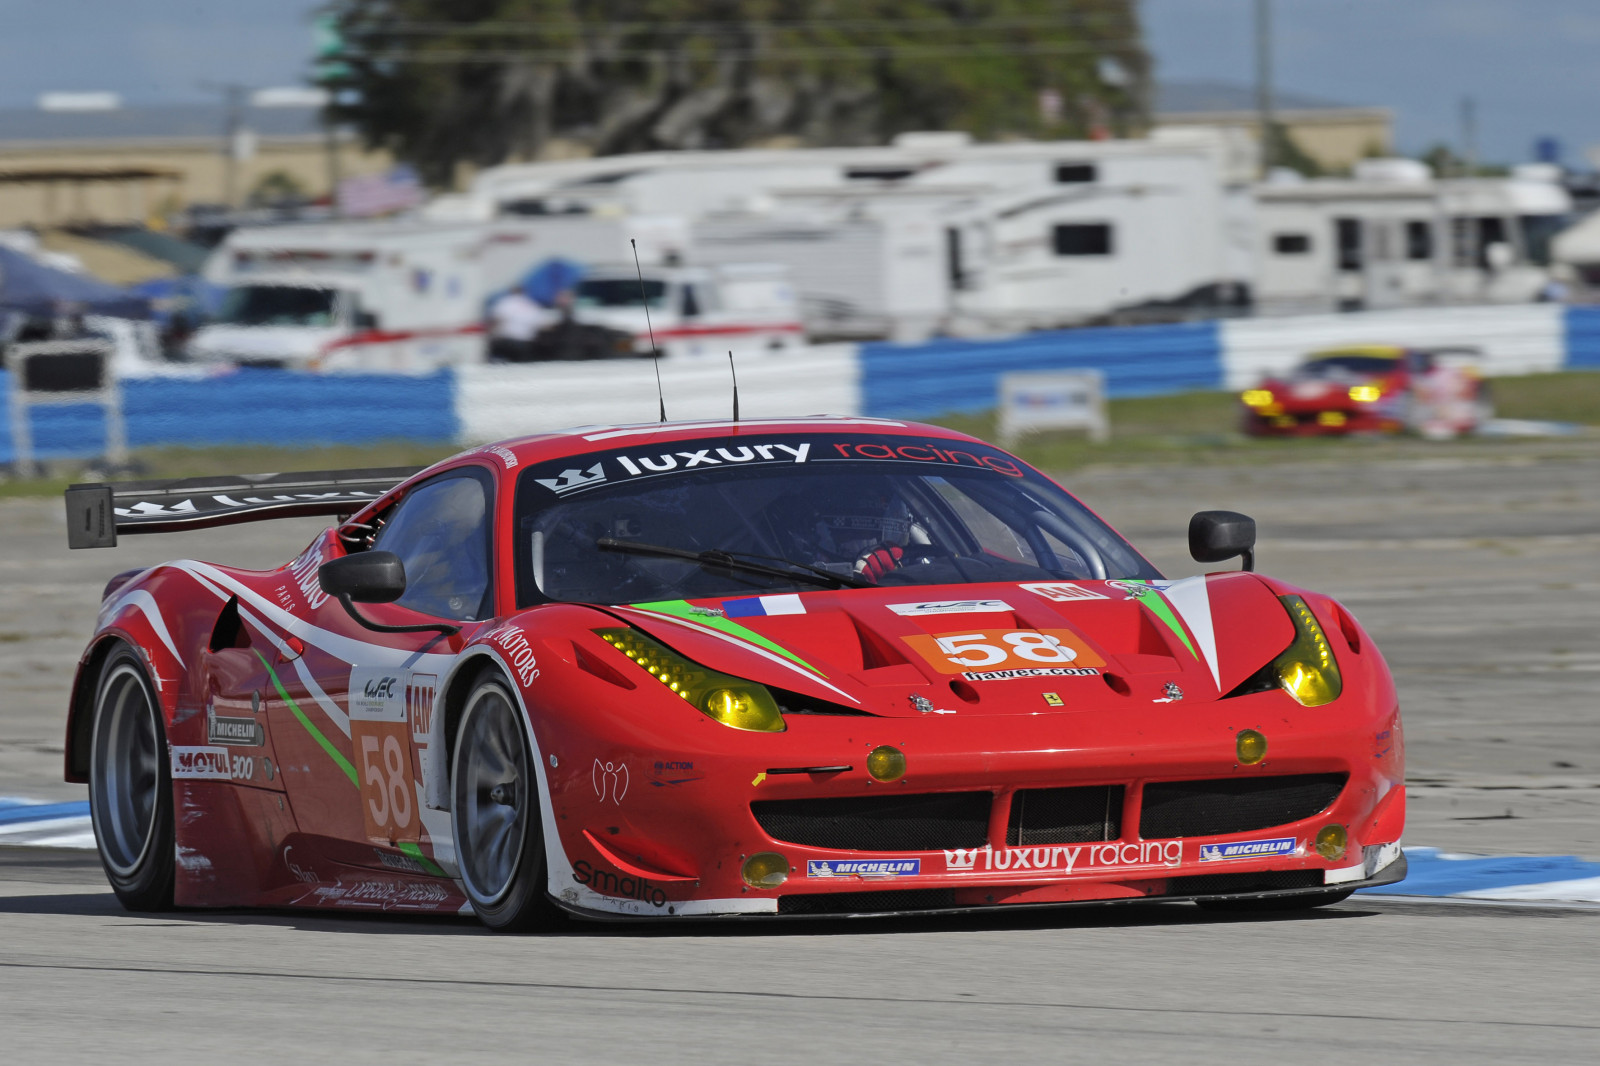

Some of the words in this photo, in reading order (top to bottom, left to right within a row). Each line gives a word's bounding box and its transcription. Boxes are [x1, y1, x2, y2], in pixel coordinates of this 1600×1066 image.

[616, 443, 810, 476] luxury
[833, 442, 1024, 477] racing
[275, 585, 296, 612] PARIS
[1043, 586, 1104, 598] AM
[494, 626, 540, 688] MOTORS
[934, 632, 1077, 667] 58
[217, 723, 254, 738] MICHELIN
[175, 752, 229, 774] MOTUL
[666, 761, 693, 770] ACTION
[361, 735, 411, 829] 58
[985, 843, 1081, 875] luxury
[1090, 841, 1182, 867] racing
[1225, 841, 1291, 855] MICHELIN
[836, 862, 915, 873] MICHELIN
[572, 860, 667, 907] Smalto
